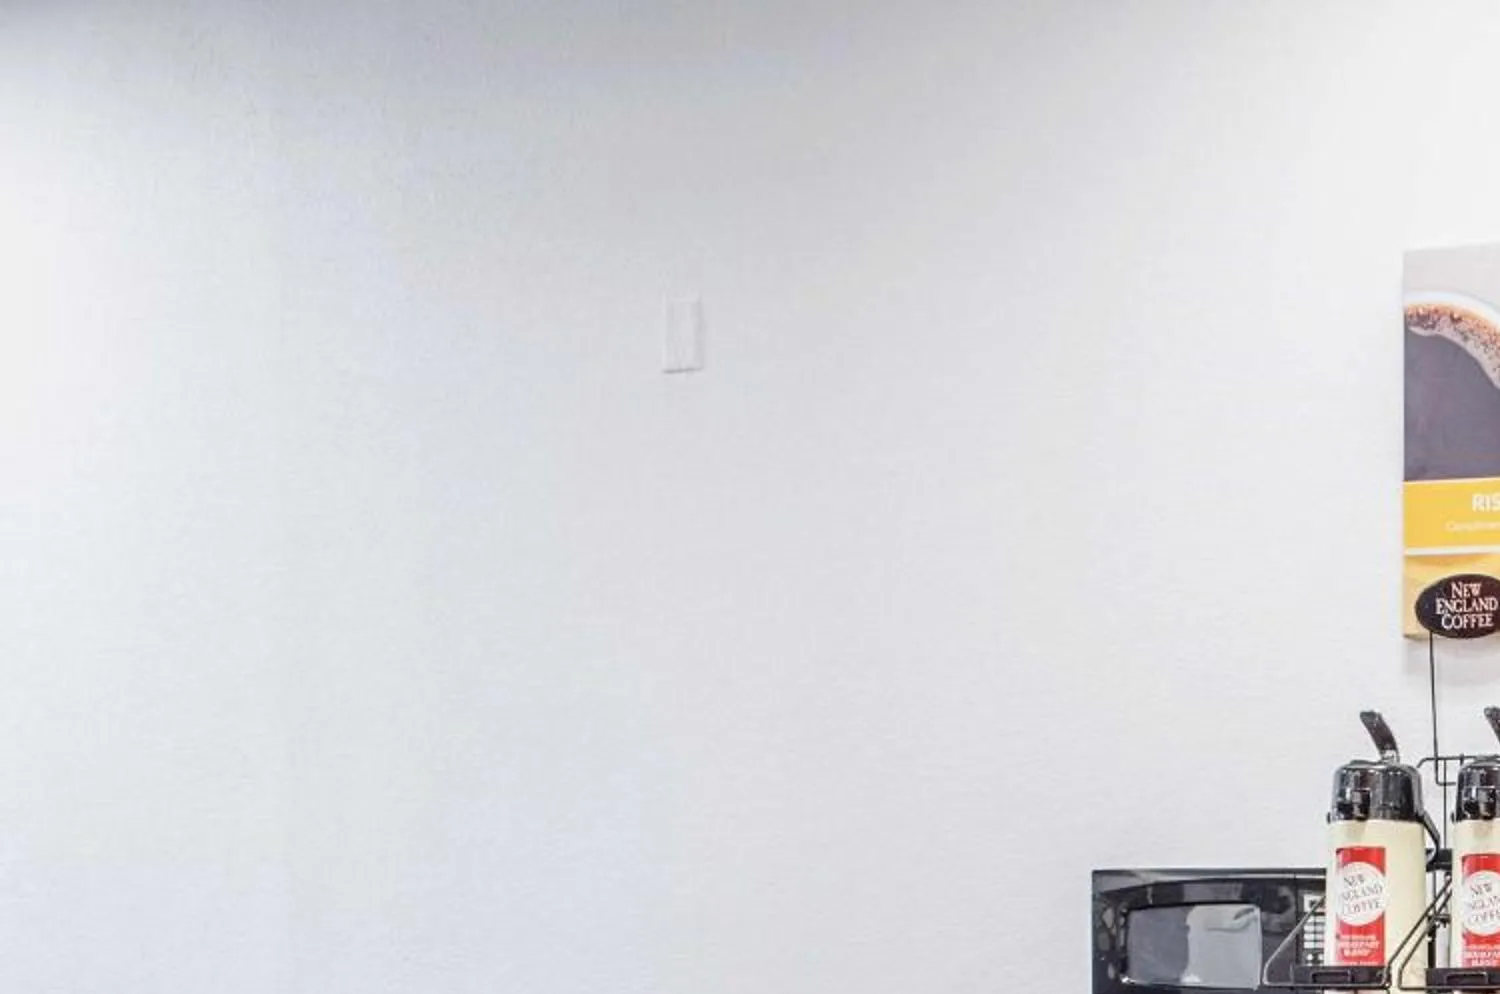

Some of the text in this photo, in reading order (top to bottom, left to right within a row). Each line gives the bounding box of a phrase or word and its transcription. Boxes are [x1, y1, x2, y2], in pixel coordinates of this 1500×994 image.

[1451, 581, 1482, 598] NEW
[1435, 597, 1499, 615] ENGLAND
[1441, 612, 1495, 630] COFFEE
[1343, 873, 1366, 887] NEW
[1338, 884, 1384, 901] NGLAND
[1470, 882, 1493, 896] NEW
